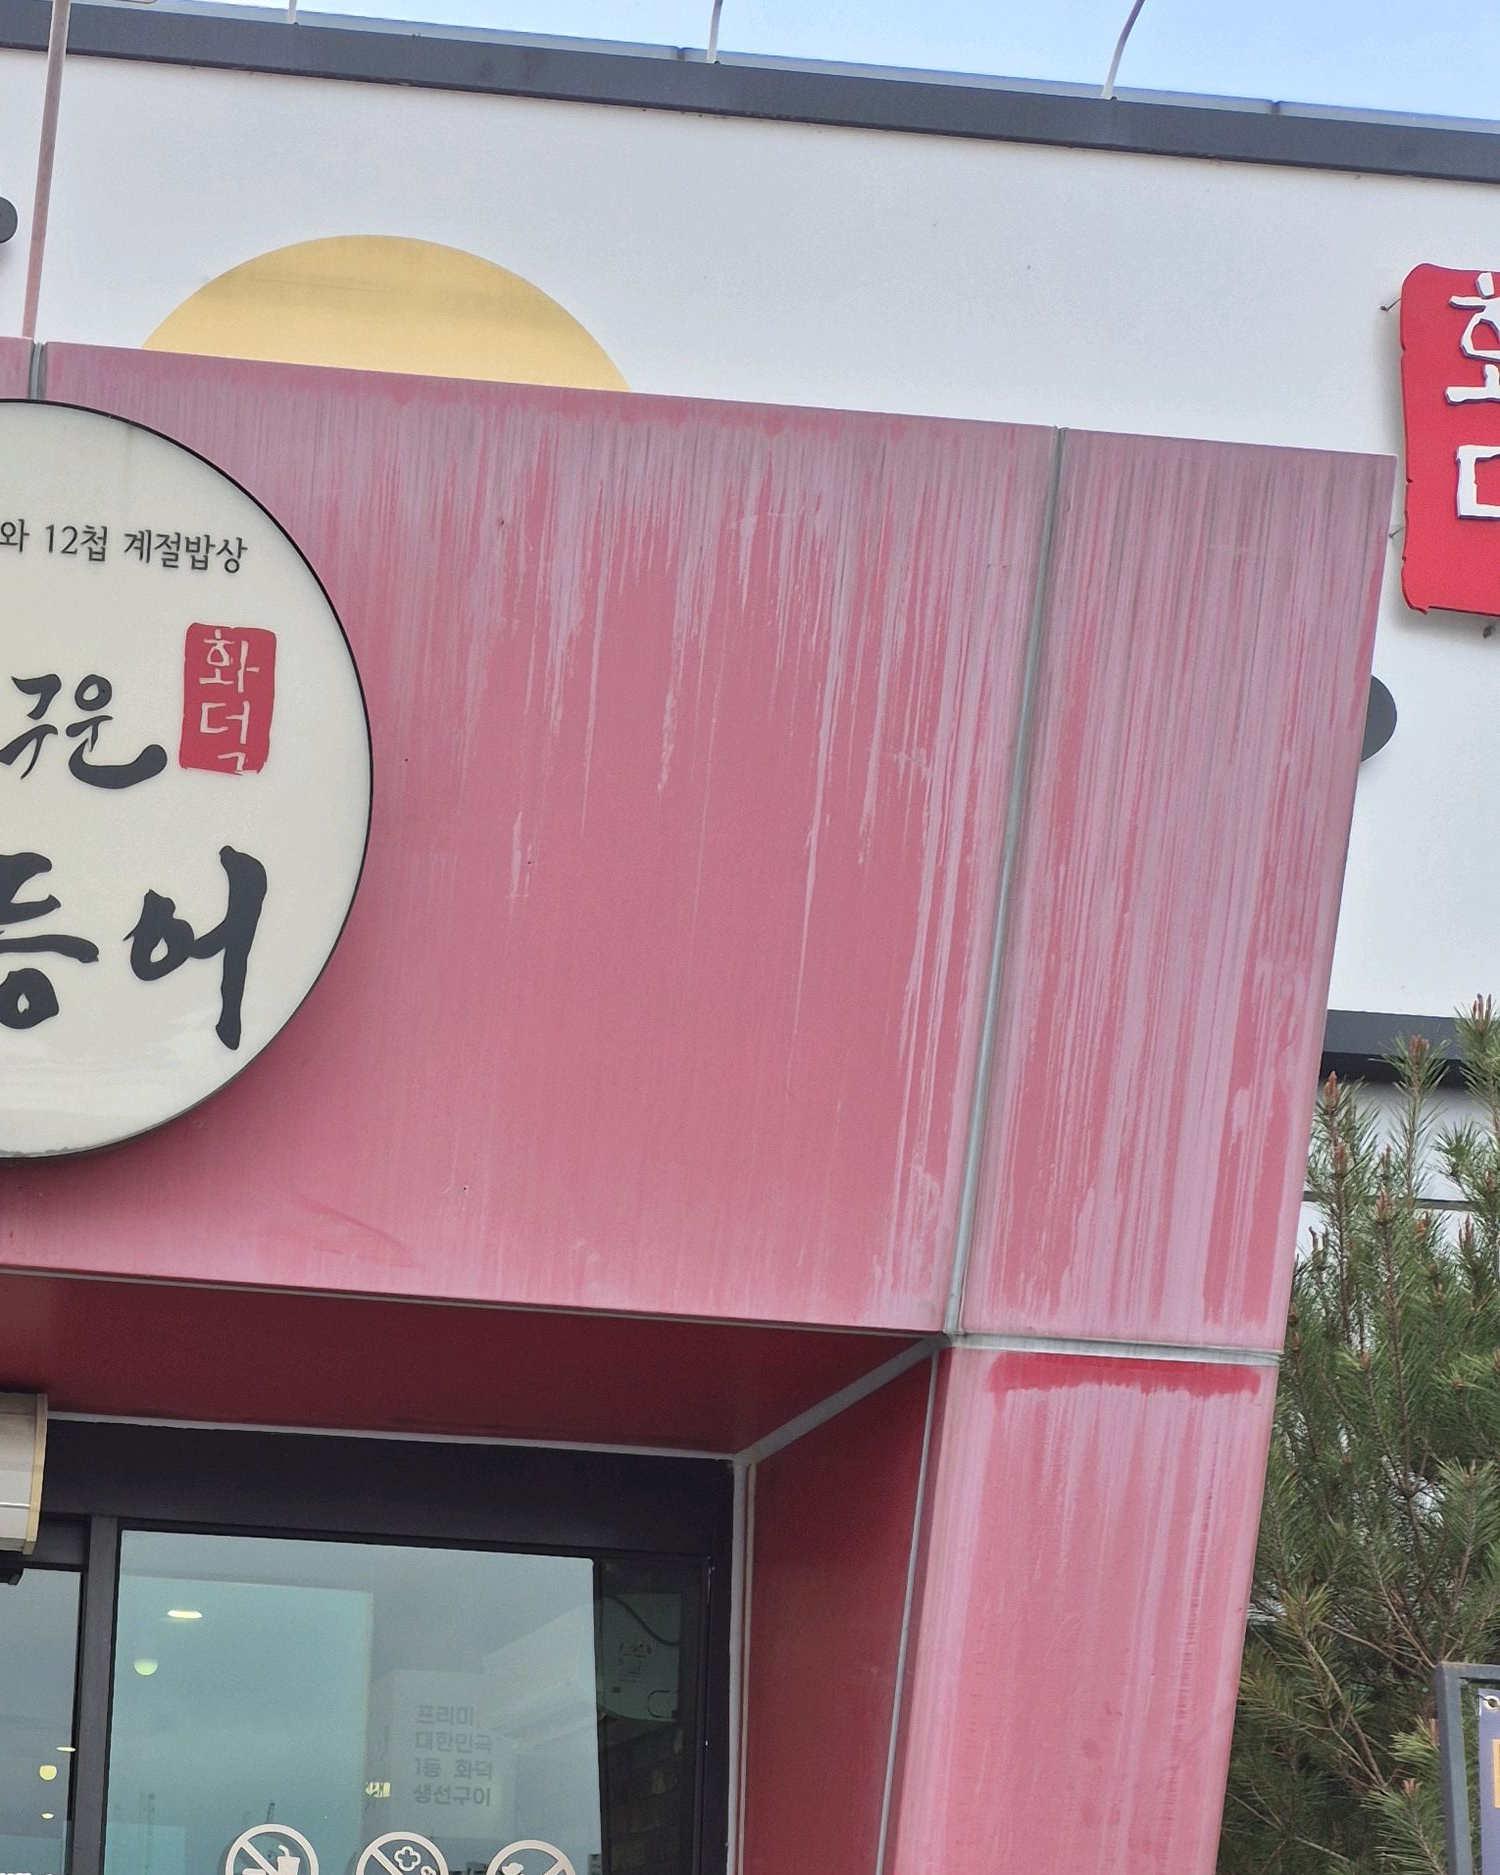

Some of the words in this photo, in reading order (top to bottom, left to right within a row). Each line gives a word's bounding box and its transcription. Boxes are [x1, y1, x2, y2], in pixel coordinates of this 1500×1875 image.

[46, 524, 107, 562] 12첩
[124, 530, 248, 573] 계절밥상
[201, 630, 259, 775] 화덕
[417, 1704, 481, 1727] 프리미
[415, 1731, 492, 1754] 대한민국
[455, 1759, 492, 1780] 화덕
[413, 1784, 491, 1807] 생선구이
